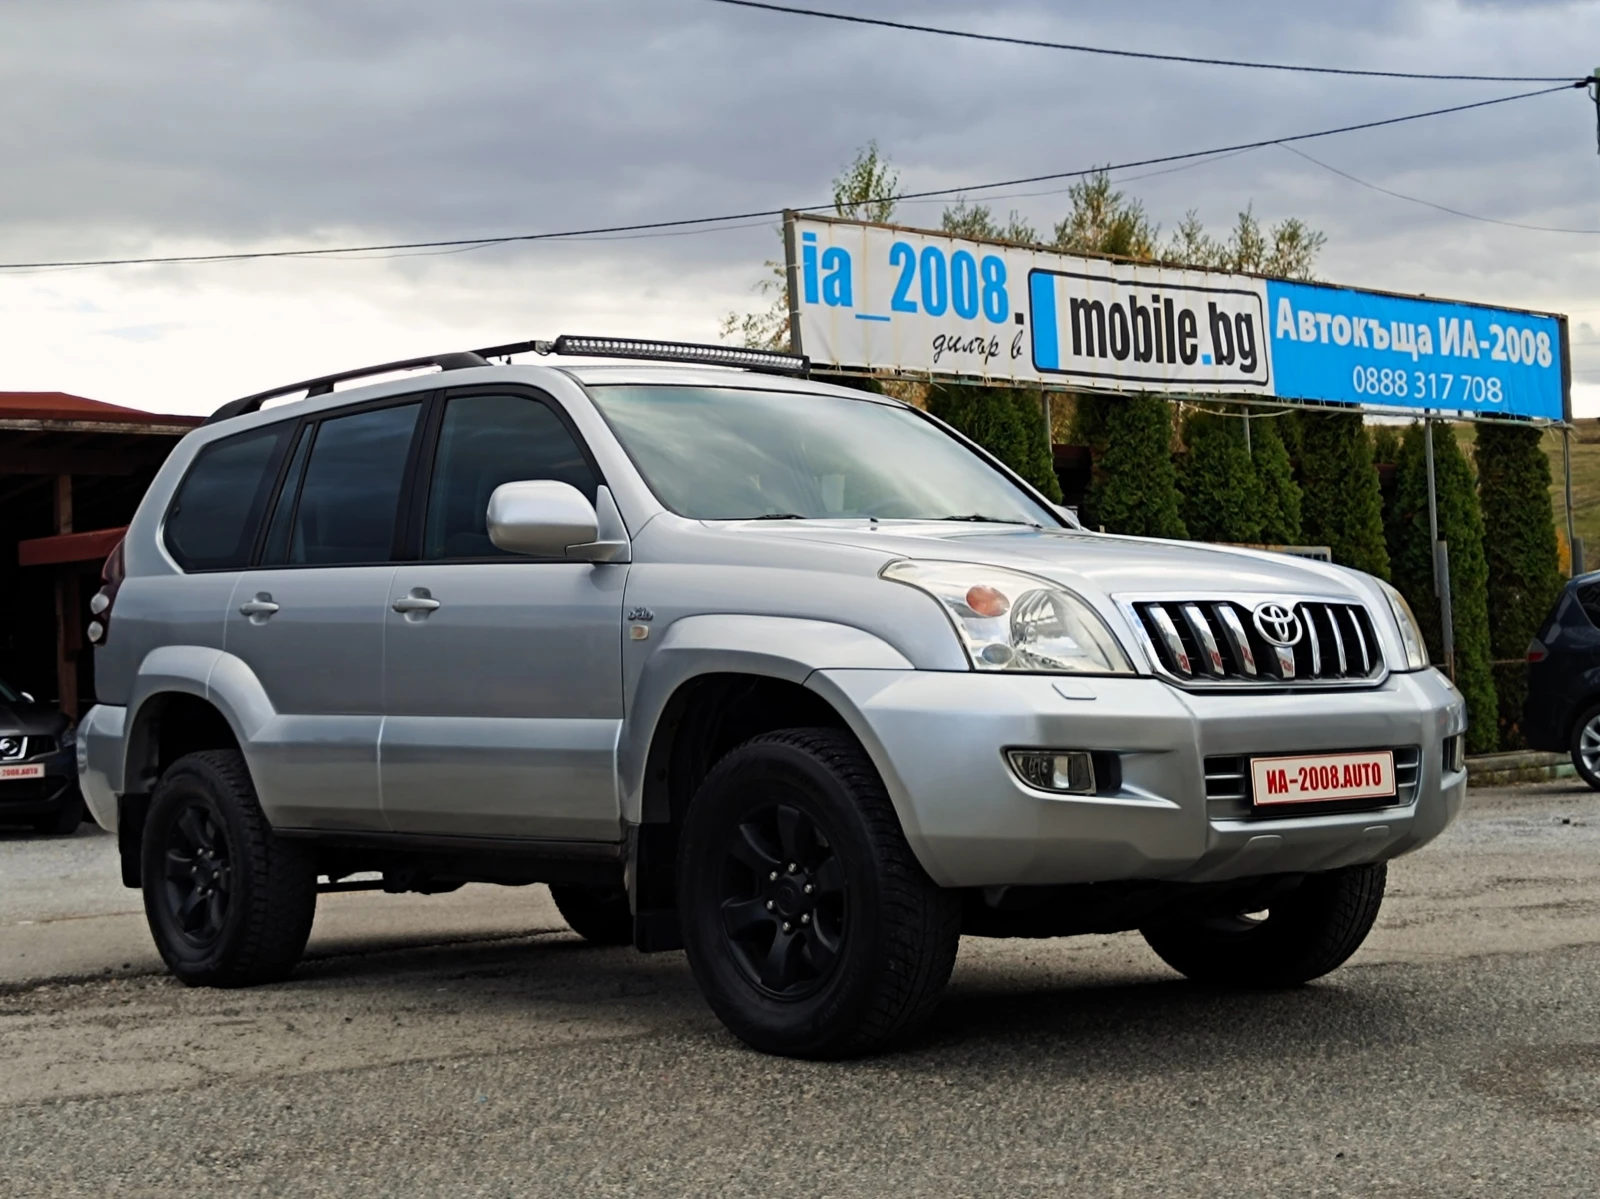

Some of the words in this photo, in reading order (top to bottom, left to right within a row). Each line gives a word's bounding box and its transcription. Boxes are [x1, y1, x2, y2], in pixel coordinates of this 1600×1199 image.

[1069, 294, 1258, 374] mobile.bg
[1276, 298, 1433, 362] Автокъща
[1439, 317, 1552, 368] ИА-2008
[1353, 365, 1408, 397] 0888
[1413, 371, 1453, 400] 317
[1460, 375, 1503, 403] 708
